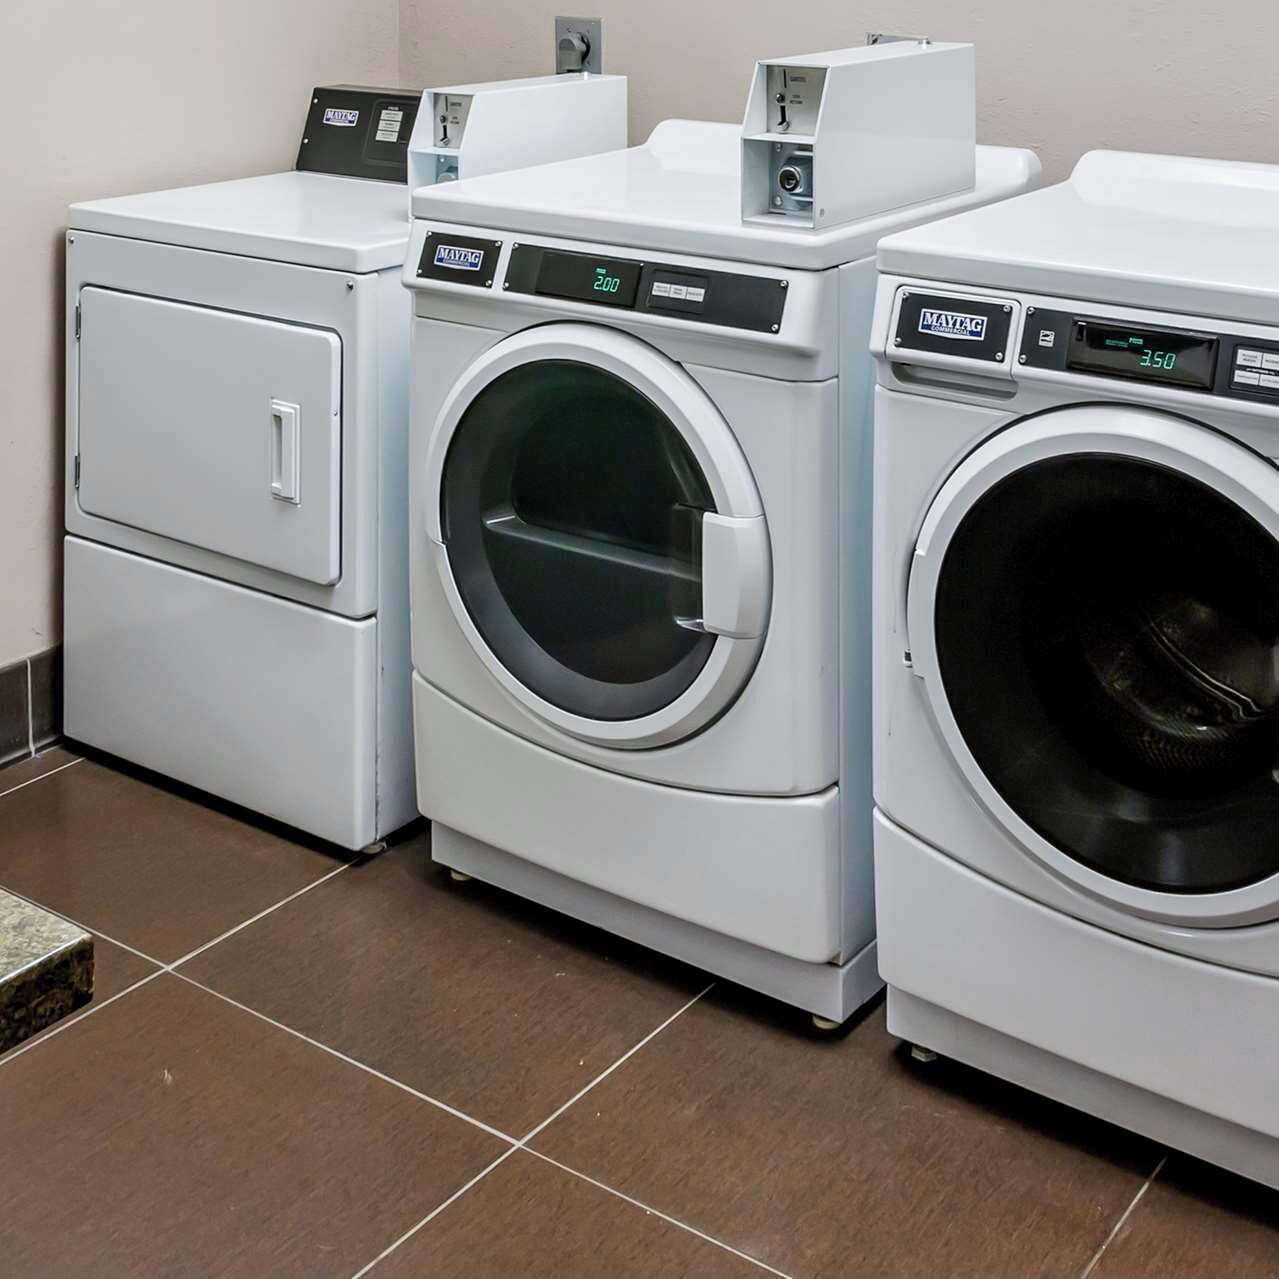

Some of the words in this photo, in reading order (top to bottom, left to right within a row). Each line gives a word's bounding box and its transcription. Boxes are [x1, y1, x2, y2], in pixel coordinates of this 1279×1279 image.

[326, 110, 356, 121] MAYTAG
[437, 247, 480, 264] MAYTAG
[593, 276, 620, 293] 2.00
[923, 312, 982, 332] MAYTAG
[931, 325, 971, 336] COMMERCIAL
[1140, 349, 1176, 370] 3.50
